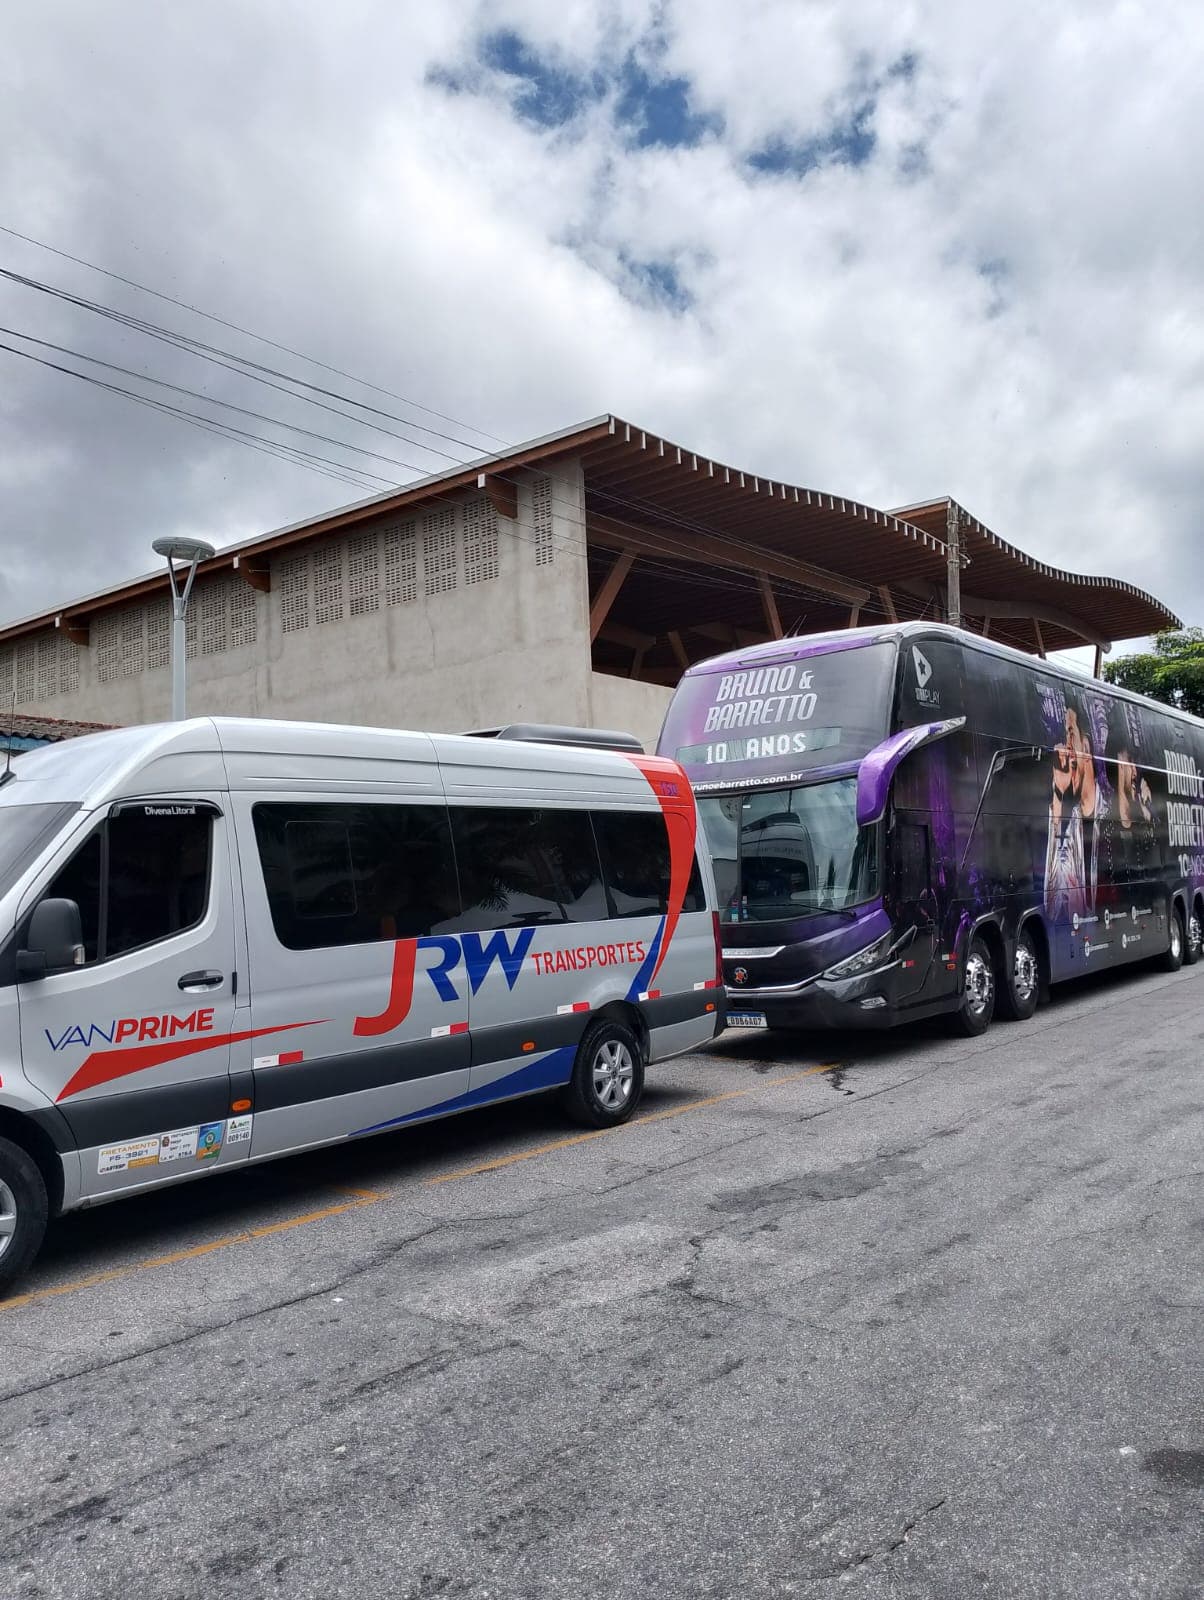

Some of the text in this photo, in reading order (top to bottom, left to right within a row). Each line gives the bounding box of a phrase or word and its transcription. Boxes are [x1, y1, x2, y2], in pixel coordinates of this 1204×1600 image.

[716, 665, 815, 702] BRUNO &
[703, 693, 818, 733] BARRETTO
[705, 732, 807, 764] 10 ANOS
[1163, 749, 1198, 798] BRUNO
[353, 928, 646, 1037] JRW TRANSPORTES
[101, 1140, 158, 1156] FRETAMENTO
